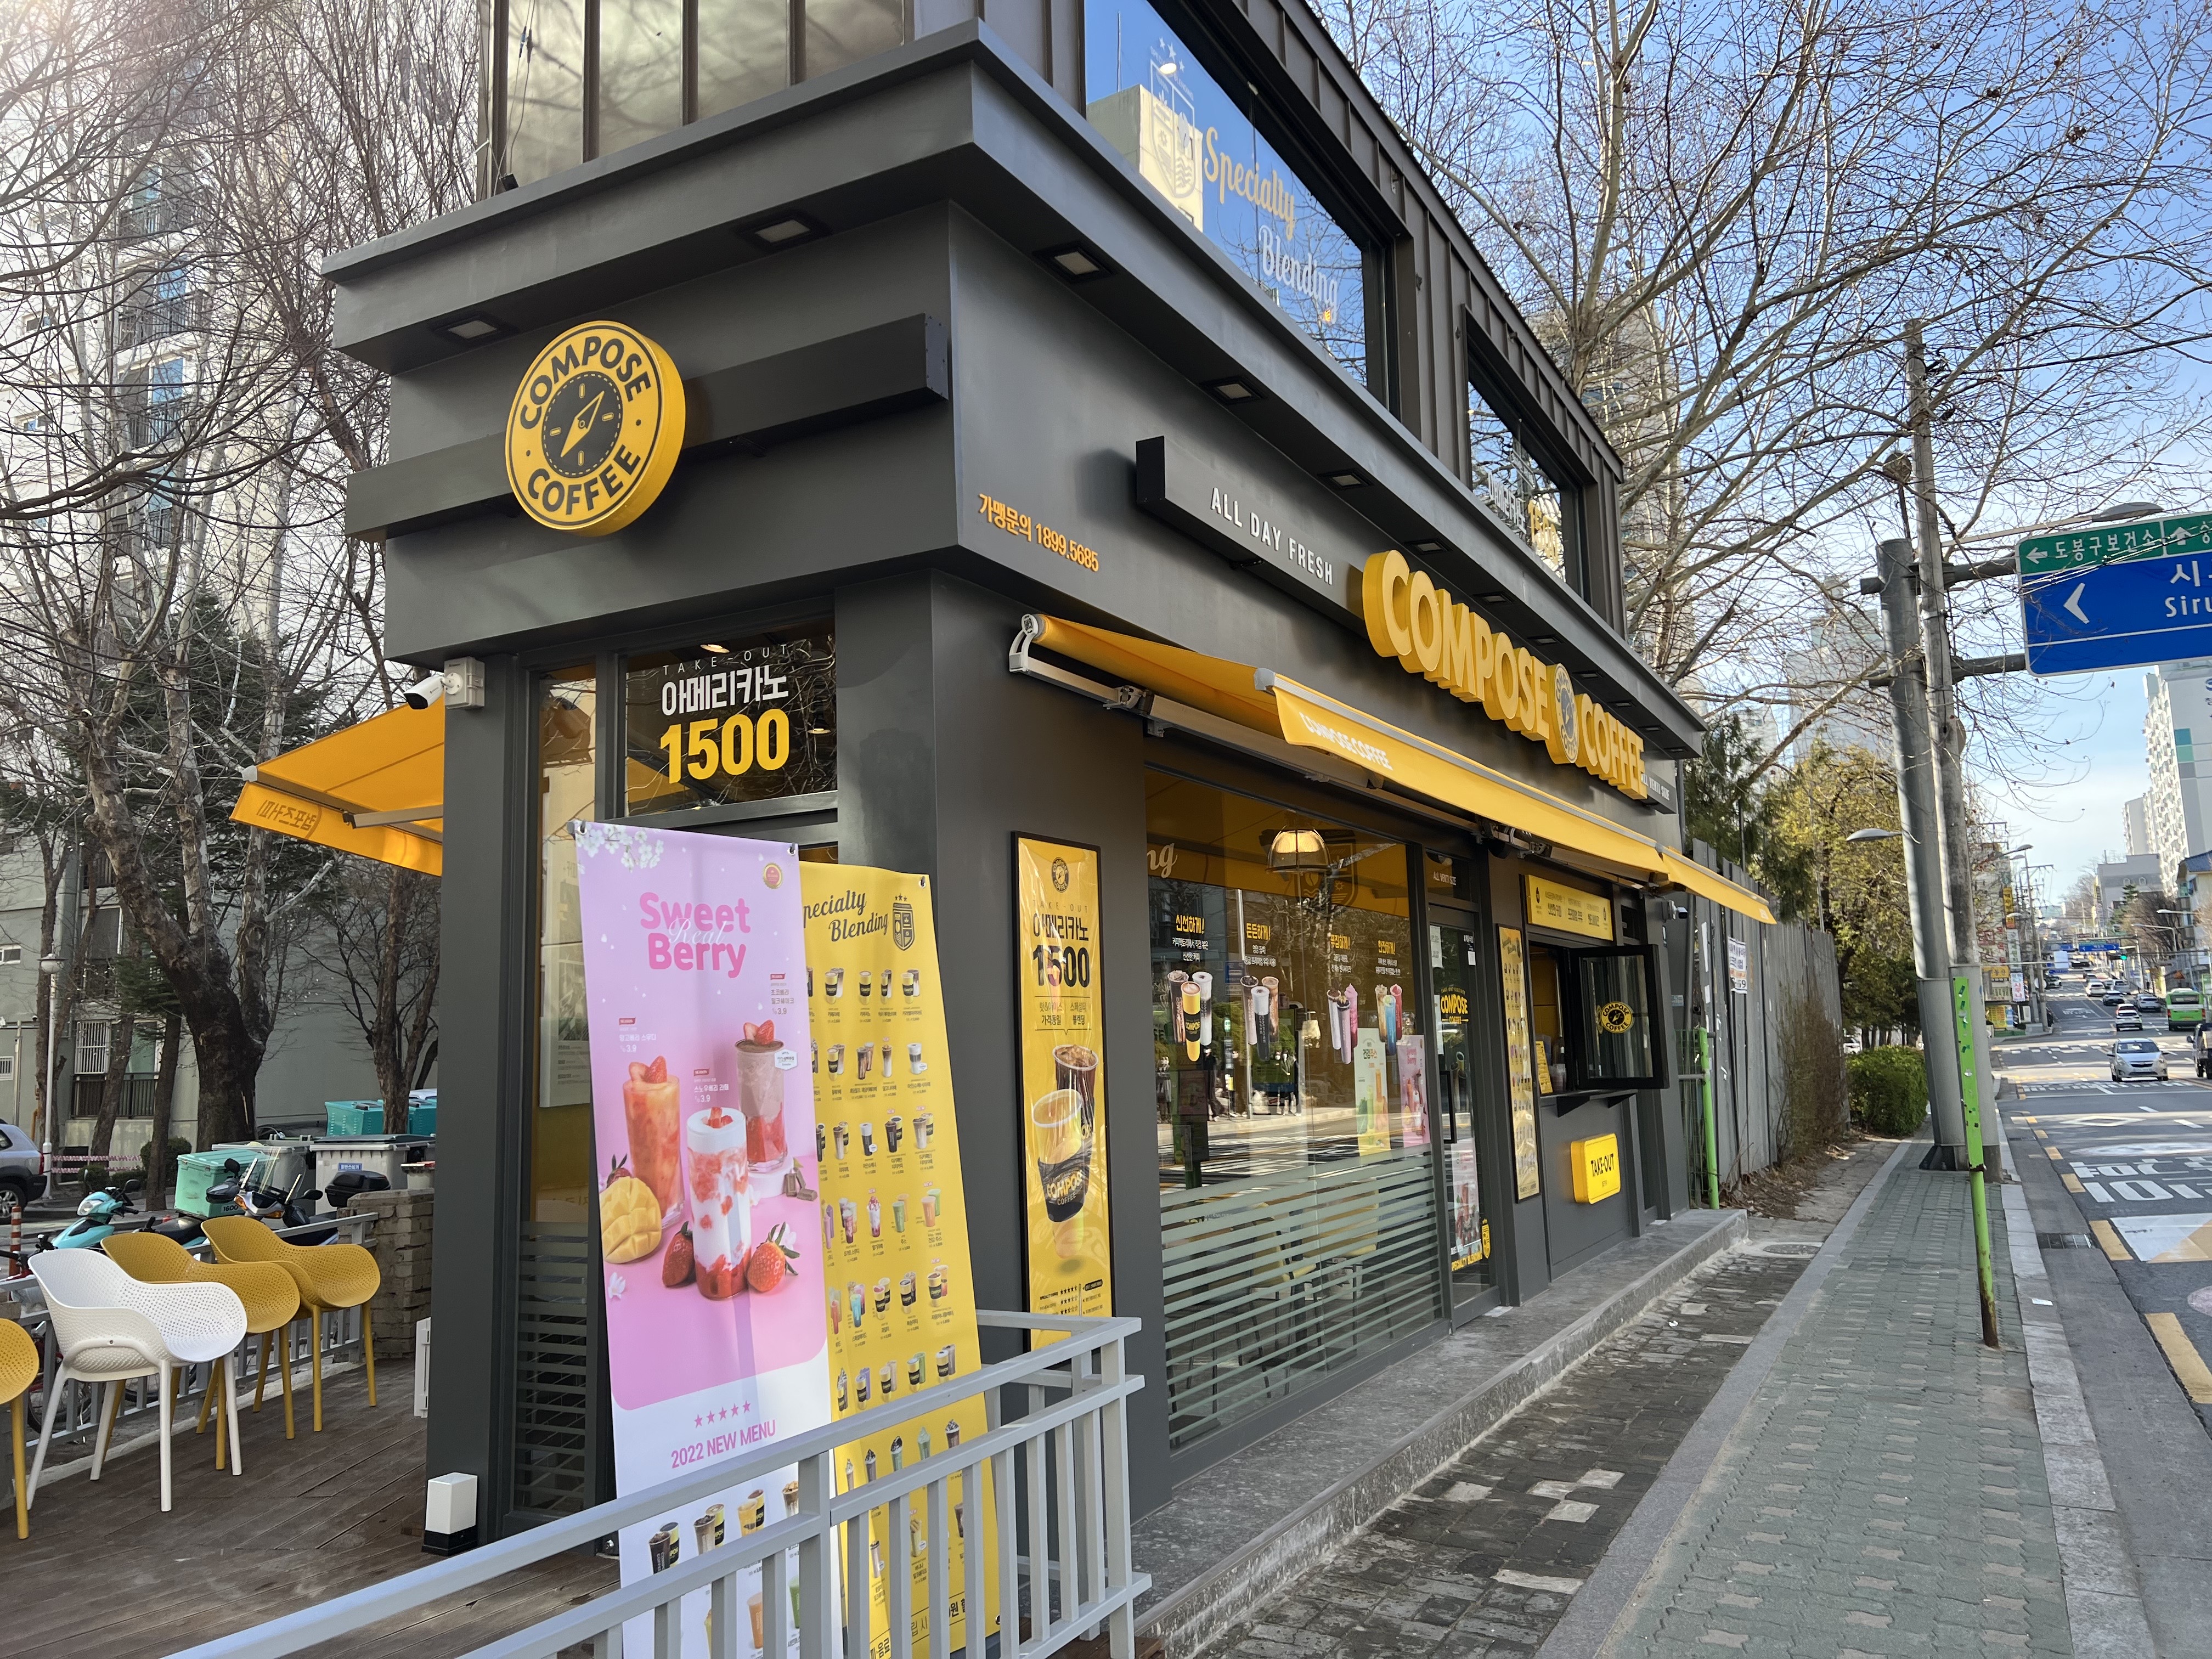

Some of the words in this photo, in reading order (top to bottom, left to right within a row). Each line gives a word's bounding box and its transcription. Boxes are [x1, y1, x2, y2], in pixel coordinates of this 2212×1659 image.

[1204, 127, 1295, 240] Specialty
[1259, 224, 1338, 324] Blending
[520, 336, 651, 429] COMPOSE
[528, 444, 641, 515] COFFEE
[979, 493, 1032, 542] 가맹문의
[1035, 523, 1099, 572] 1899.5685
[1211, 487, 1243, 527] ALL
[1250, 512, 1282, 551] DAY
[1289, 537, 1333, 585] FRESH
[2055, 529, 2155, 561] 도봉구보건소
[663, 644, 787, 675] TAKE-OUT
[1365, 550, 1550, 741] COMPOSE
[1577, 693, 1647, 799] COFFEE
[662, 665, 789, 715] 아메리카노
[661, 708, 789, 784] 1500
[640, 892, 751, 933] Sweet
[803, 890, 867, 928] pecialty
[828, 912, 888, 941] Blending
[1033, 913, 1089, 941] 아메리카노
[1176, 914, 1205, 934] 신선하게!
[669, 917, 728, 944] Real
[1246, 922, 1271, 940] 든든하게!
[648, 933, 747, 978] Berry
[1033, 944, 1090, 988] 1500
[1042, 1015, 1062, 1025] 가격동일
[1441, 994, 1468, 1014] COMPOSE
[1603, 1004, 1629, 1017] COMPOSE
[1606, 1022, 1628, 1031] COFFEE
[1590, 1153, 1614, 1177] TAKE-OUT
[1057, 1191, 1076, 1206] COFFEE
[671, 1443, 704, 1469] 2022
[707, 1431, 736, 1457] NEW
[740, 1420, 776, 1446] MENU
